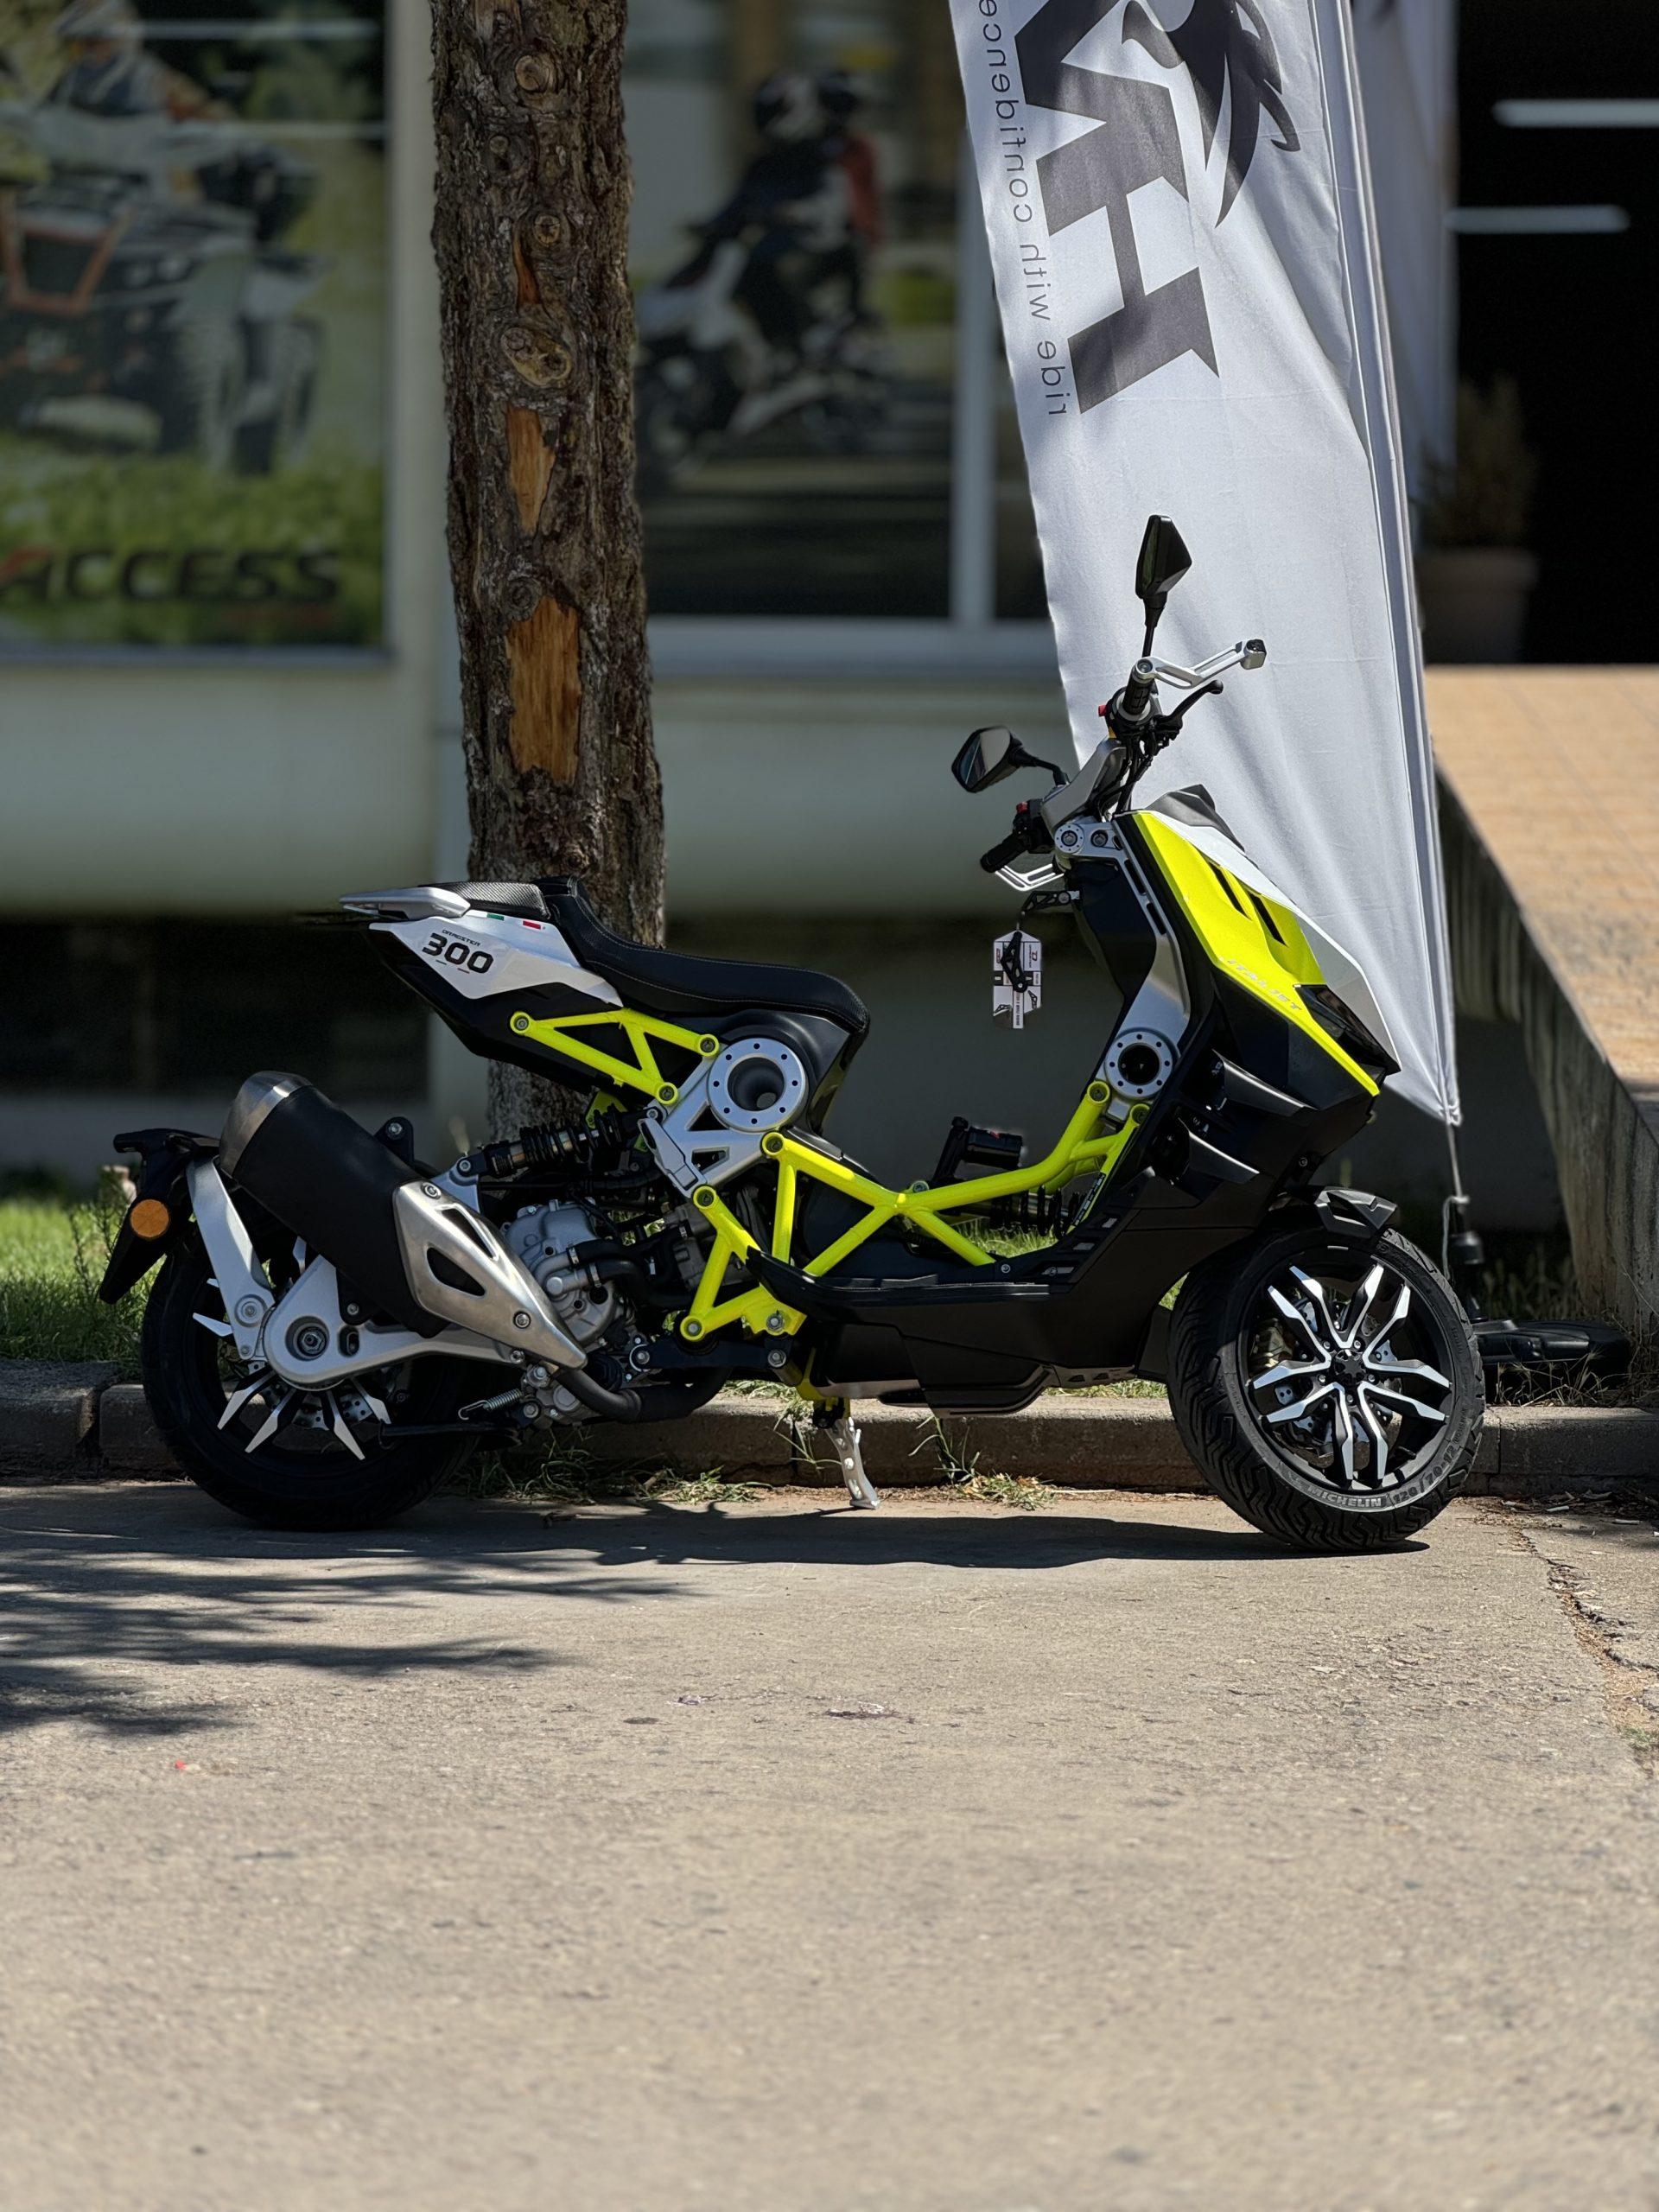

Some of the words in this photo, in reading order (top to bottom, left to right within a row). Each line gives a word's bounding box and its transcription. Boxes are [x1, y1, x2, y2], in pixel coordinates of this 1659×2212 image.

[0, 546, 340, 603] ACCESS
[422, 932, 494, 974] 300
[1307, 1485, 1382, 1508] MICHELIN
